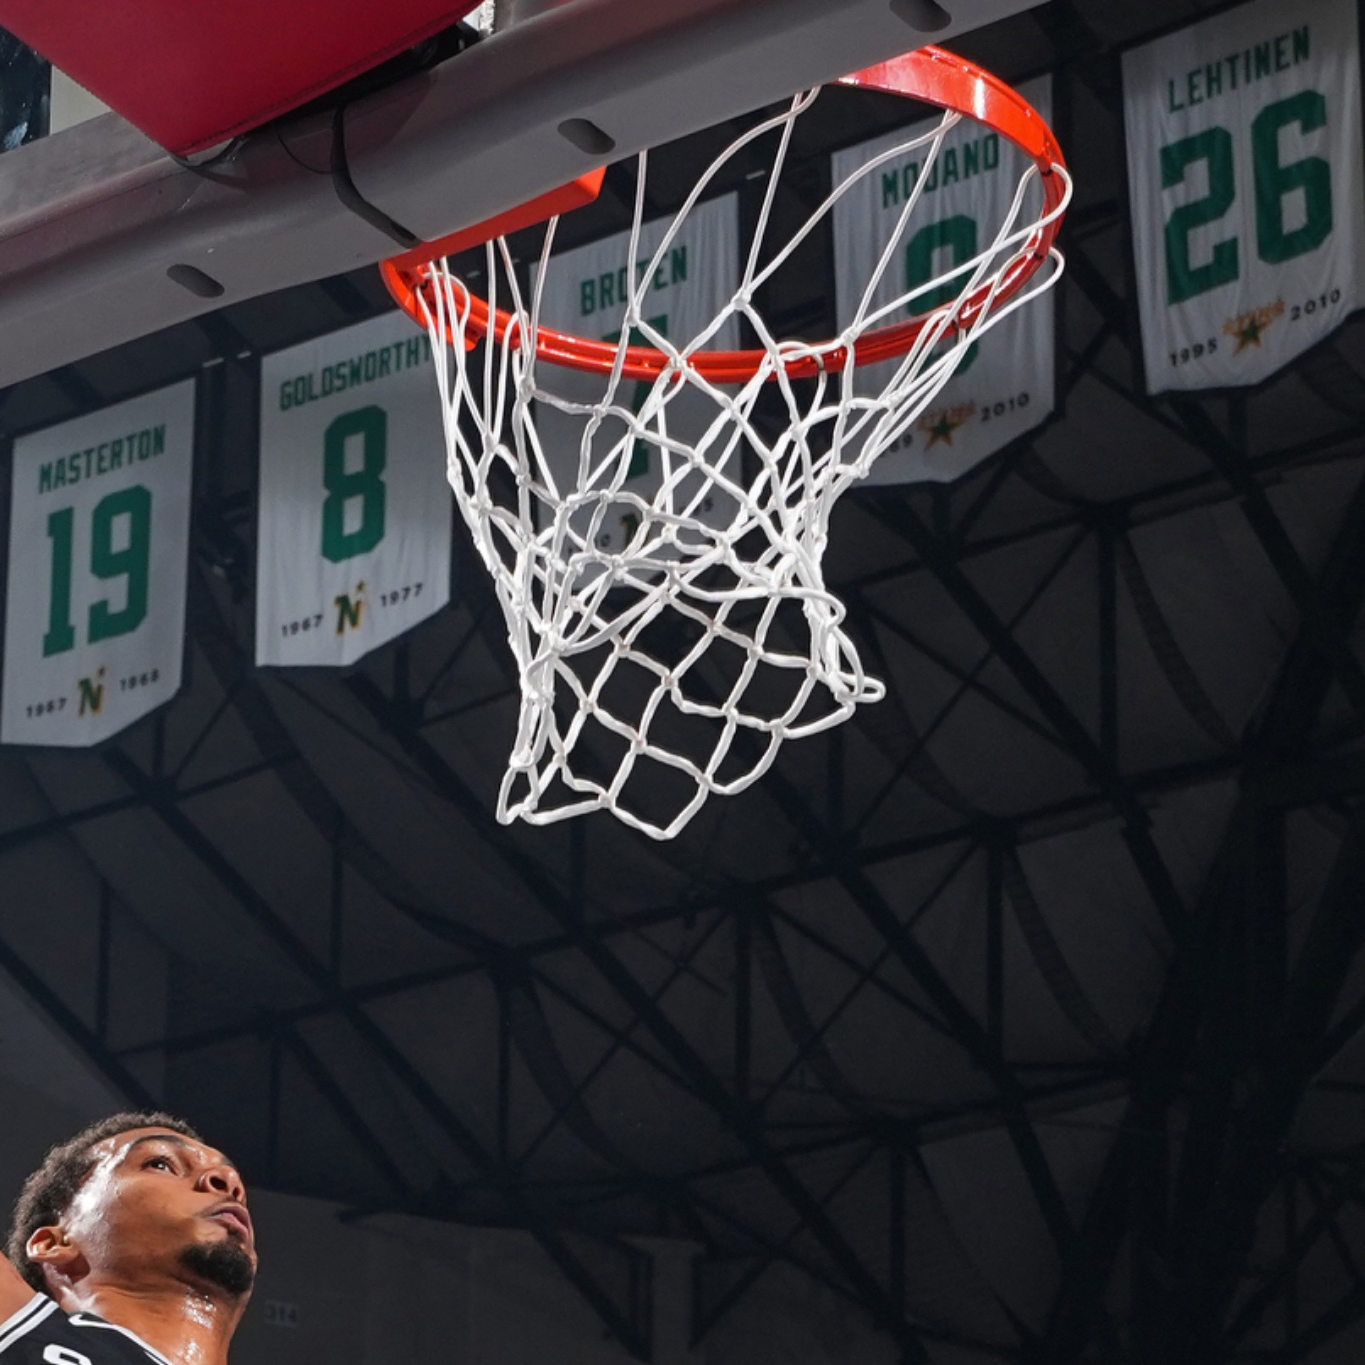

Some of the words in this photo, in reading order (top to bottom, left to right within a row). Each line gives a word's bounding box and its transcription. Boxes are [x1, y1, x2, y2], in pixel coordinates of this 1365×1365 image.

[1169, 25, 1310, 113] LEHTINEN
[1160, 89, 1333, 306] 26
[1290, 289, 1341, 323] 2010
[280, 331, 433, 411] GOLDSWORTHY
[980, 392, 1031, 423] 2010
[38, 423, 166, 495] MASTERTON
[321, 403, 388, 565] 8
[42, 484, 153, 659] 19
[282, 613, 324, 638] 1967
[380, 582, 424, 608] 1977
